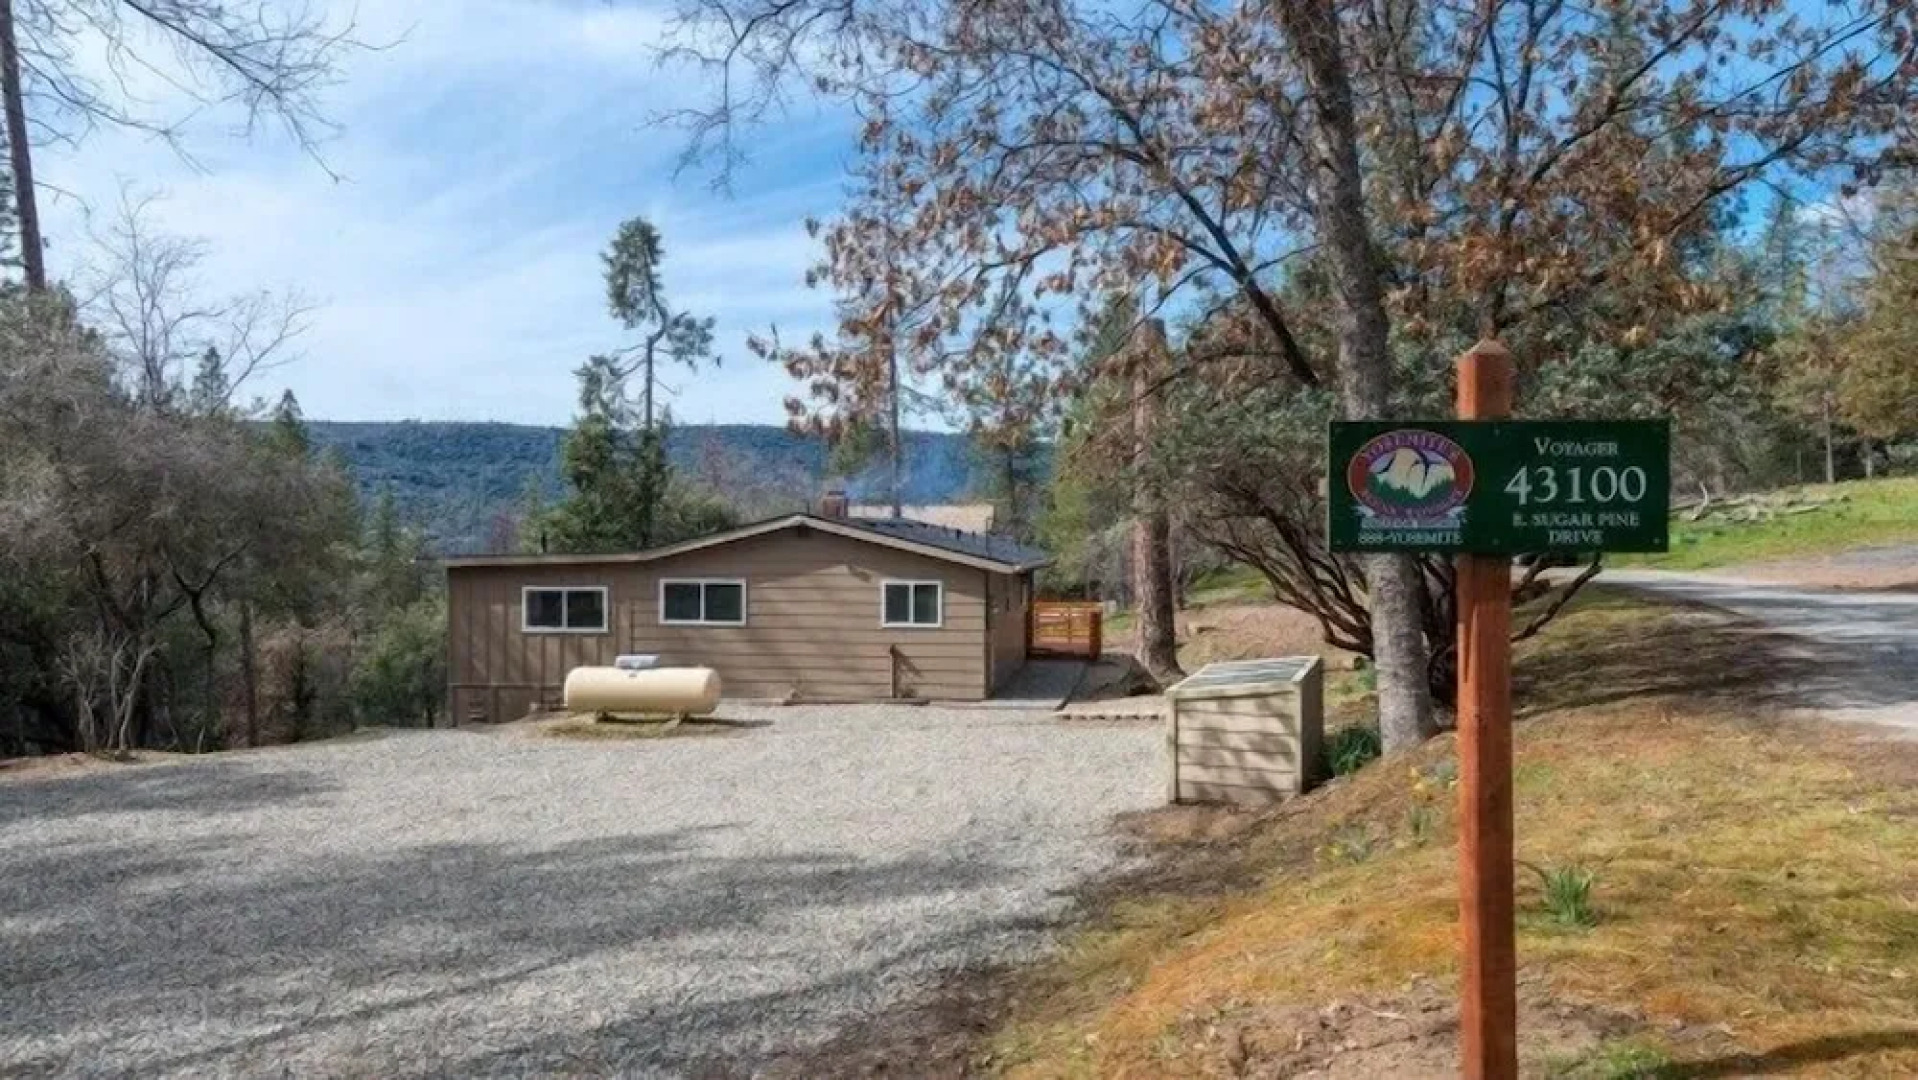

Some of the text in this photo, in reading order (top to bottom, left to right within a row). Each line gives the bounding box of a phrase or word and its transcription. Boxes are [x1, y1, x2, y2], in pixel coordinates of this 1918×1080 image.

[1503, 465, 1647, 506] 43100
[1532, 512, 1594, 526] SUGAR
[1598, 512, 1640, 526] PINE
[1549, 529, 1604, 544] DRIVE
